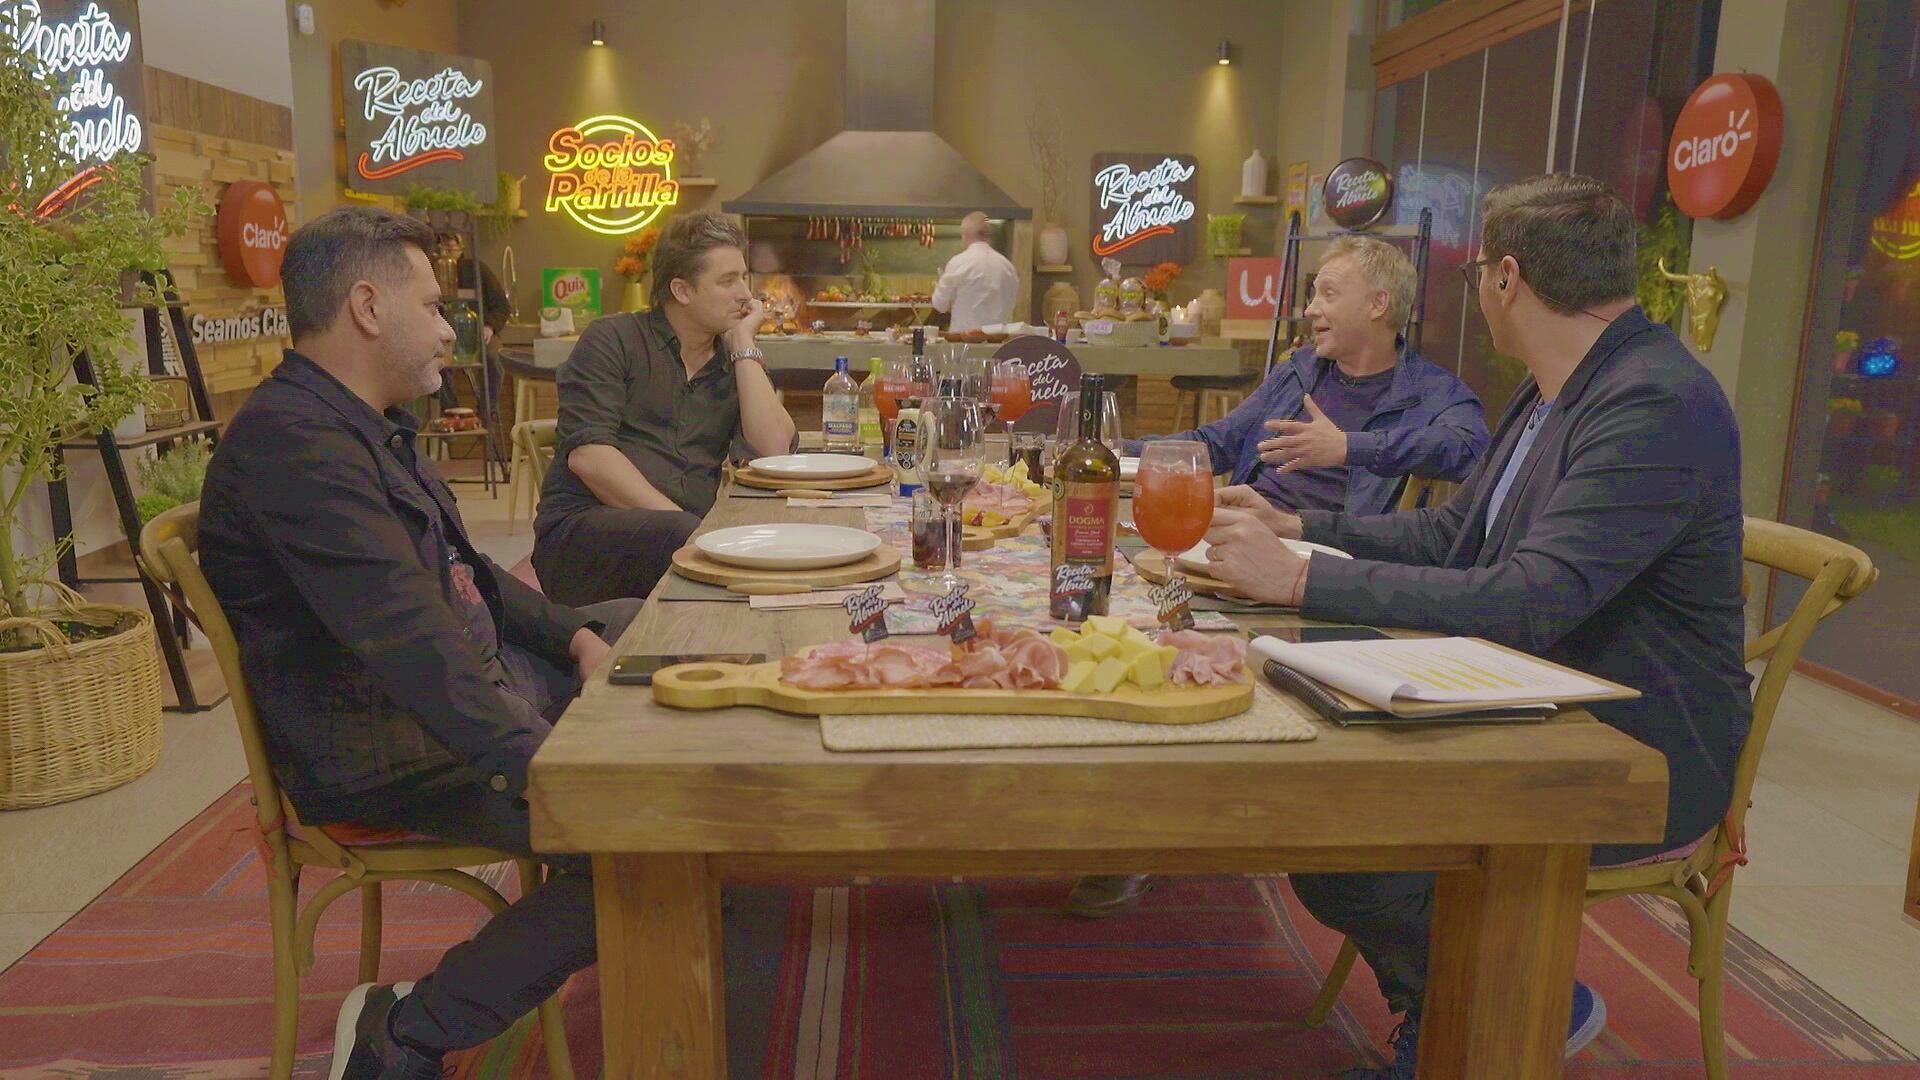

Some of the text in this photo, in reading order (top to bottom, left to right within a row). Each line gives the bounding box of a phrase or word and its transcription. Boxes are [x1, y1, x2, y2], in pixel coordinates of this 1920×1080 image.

[354, 66, 483, 121] Receta
[420, 100, 462, 124] del
[370, 113, 487, 162] Abuelo
[544, 127, 676, 172] Socios
[1673, 129, 1740, 172] Claro
[545, 172, 680, 212] Parrilla
[1095, 158, 1195, 210] Receta
[1336, 169, 1380, 194] Receta
[1142, 185, 1176, 207] del
[1335, 190, 1379, 209] Abuelo
[1102, 194, 1195, 242] Abuelo
[243, 223, 281, 250] Claro
[553, 276, 586, 301] Quix
[191, 313, 261, 345] Seamos
[262, 307, 291, 337] Cla
[1030, 378, 1069, 403] uelo
[1032, 371, 1054, 387] del
[1068, 515, 1105, 525] DOGMA
[1056, 564, 1096, 580] Receta
[1055, 579, 1094, 593] Abuelo
